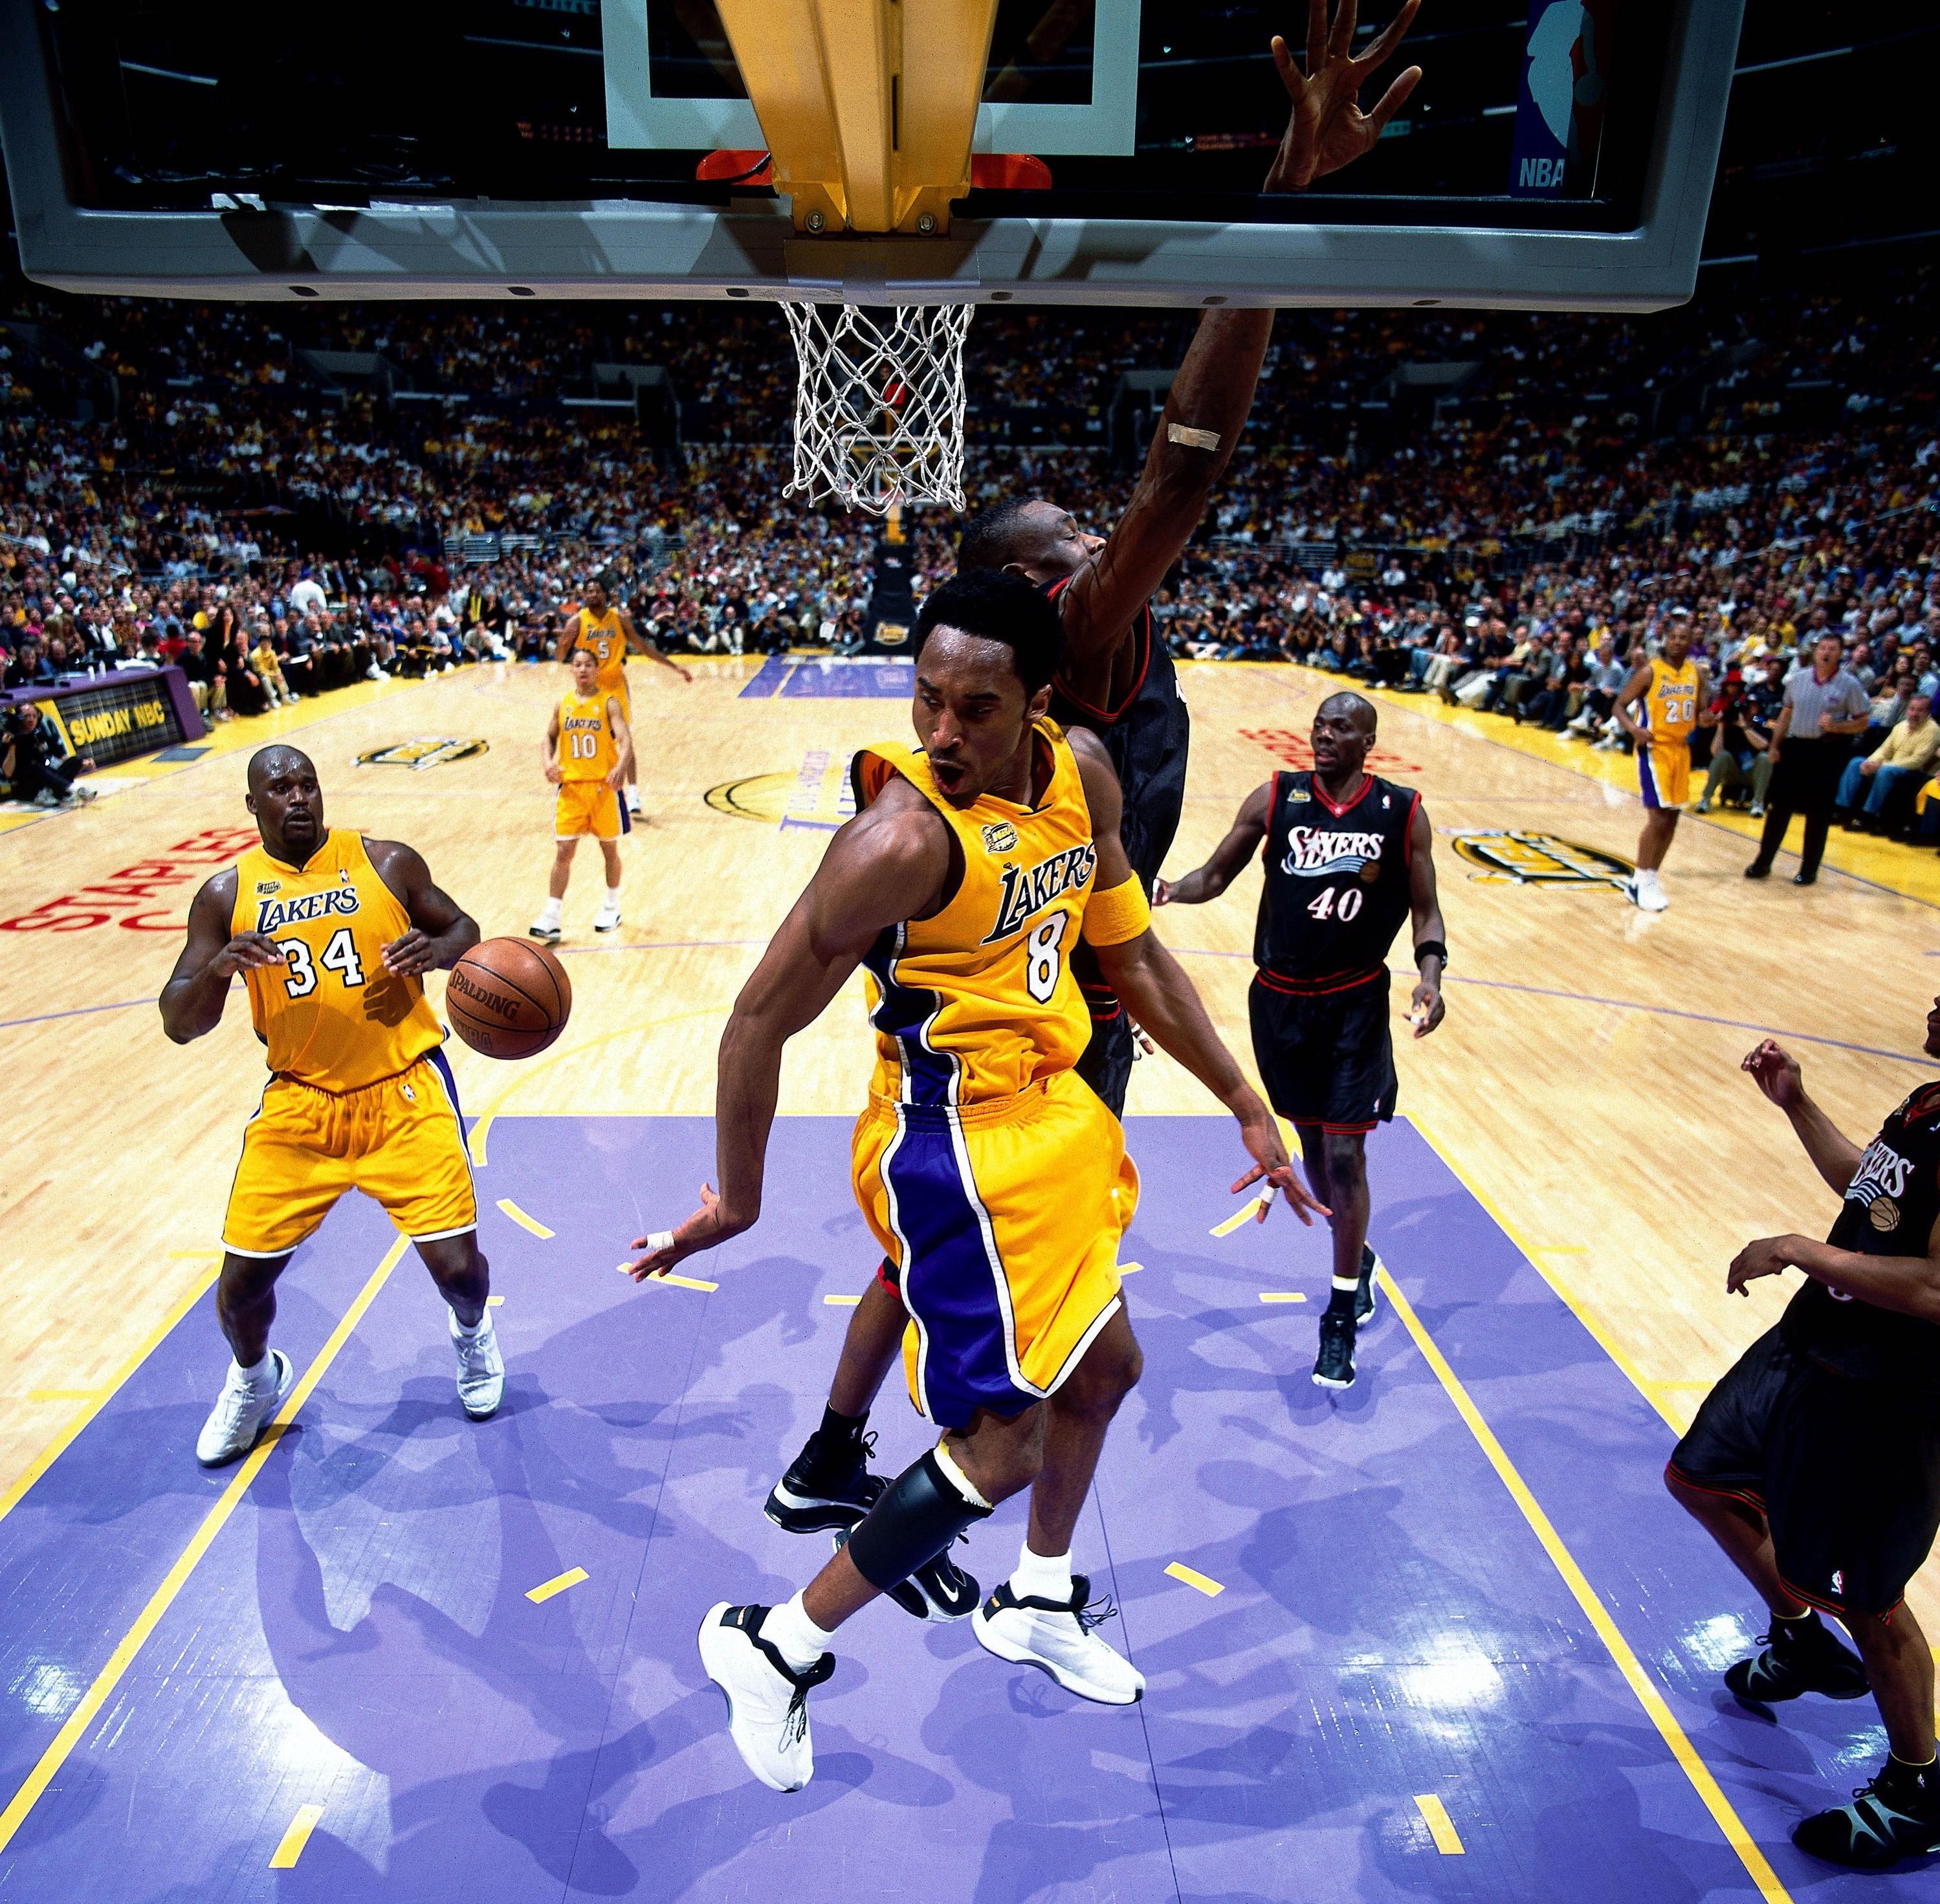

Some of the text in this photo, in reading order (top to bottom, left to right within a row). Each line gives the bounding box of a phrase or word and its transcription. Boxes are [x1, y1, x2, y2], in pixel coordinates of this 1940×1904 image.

[1519, 157, 1565, 188] NBA
[597, 640, 610, 659] 5
[69, 699, 165, 747] SUNDAY NBC
[564, 716, 602, 731] LAKERS
[1665, 700, 1694, 723] 20
[571, 733, 597, 759] 10
[0, 826, 263, 933] STAPLES
[979, 841, 1096, 946] LAKERS
[256, 886, 361, 936] LAKERS
[1307, 887, 1363, 922] 40
[276, 927, 366, 999] 34
[1026, 908, 1070, 1005] 8
[449, 968, 522, 1022] SPALDING
